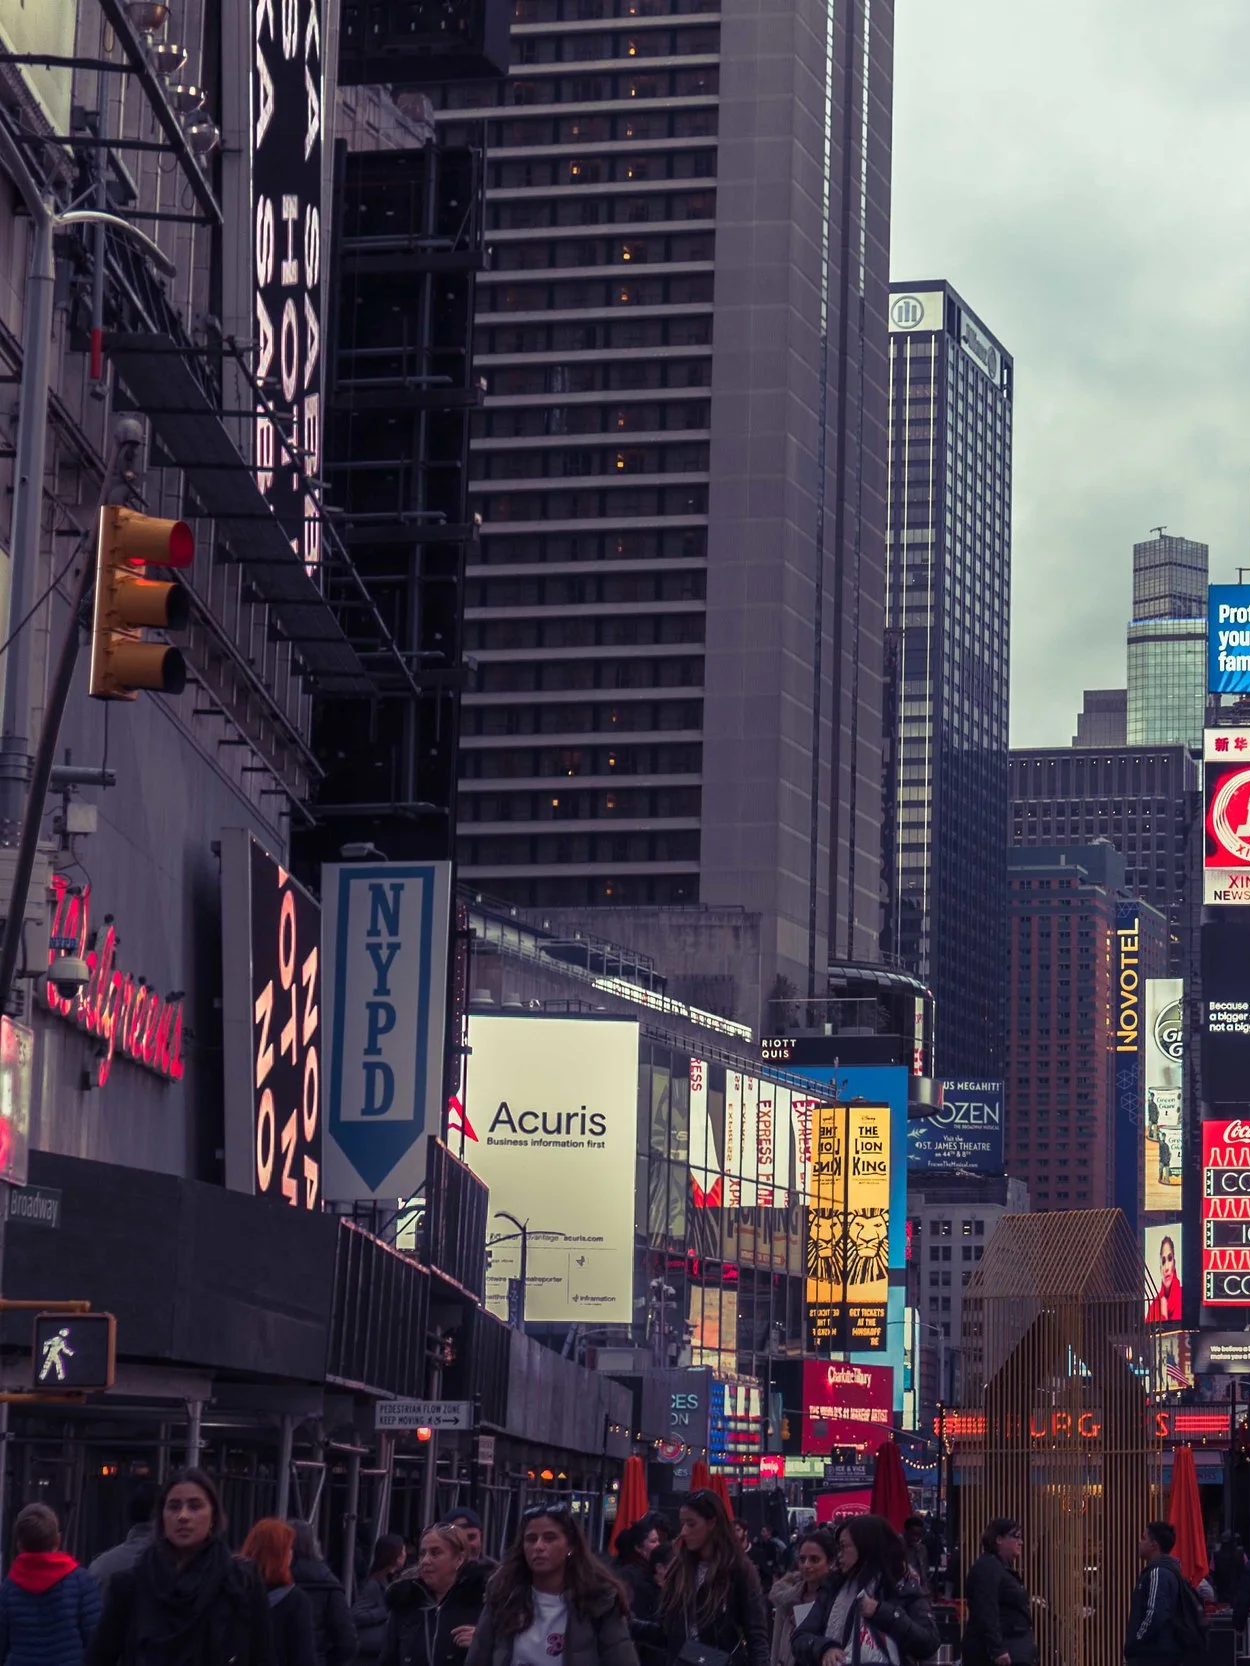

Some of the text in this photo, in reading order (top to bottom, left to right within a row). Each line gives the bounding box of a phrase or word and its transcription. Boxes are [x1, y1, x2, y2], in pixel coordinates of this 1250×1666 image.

[1214, 890, 1250, 900] NEWS
[1116, 917, 1139, 1052] NOVOTEL
[361, 882, 405, 1117] NYPD
[1209, 1001, 1248, 1010] Because
[1209, 1013, 1217, 1021] a
[1218, 1012, 1248, 1022] bigger
[1209, 1023, 1225, 1031] not
[762, 1039, 797, 1048] RIOTT
[762, 1050, 789, 1058] QUIS
[957, 1082, 999, 1092] MEGAHIT!
[488, 1101, 606, 1137] Acuris
[928, 1102, 999, 1127] OZEN
[758, 1100, 772, 1165] EXPRESS
[858, 1126, 878, 1135] THE
[487, 1137, 605, 1149] Business information first
[855, 1138, 883, 1154] LION
[922, 1142, 991, 1151] ST. JAMES THEATRE
[852, 1156, 886, 1176] KING
[11, 1189, 58, 1228] Broadway
[828, 1366, 854, 1384] Charlotte
[380, 1404, 460, 1414] PEDESTRIAN FLOW ZONE
[380, 1416, 424, 1425] KEEP MOVING
